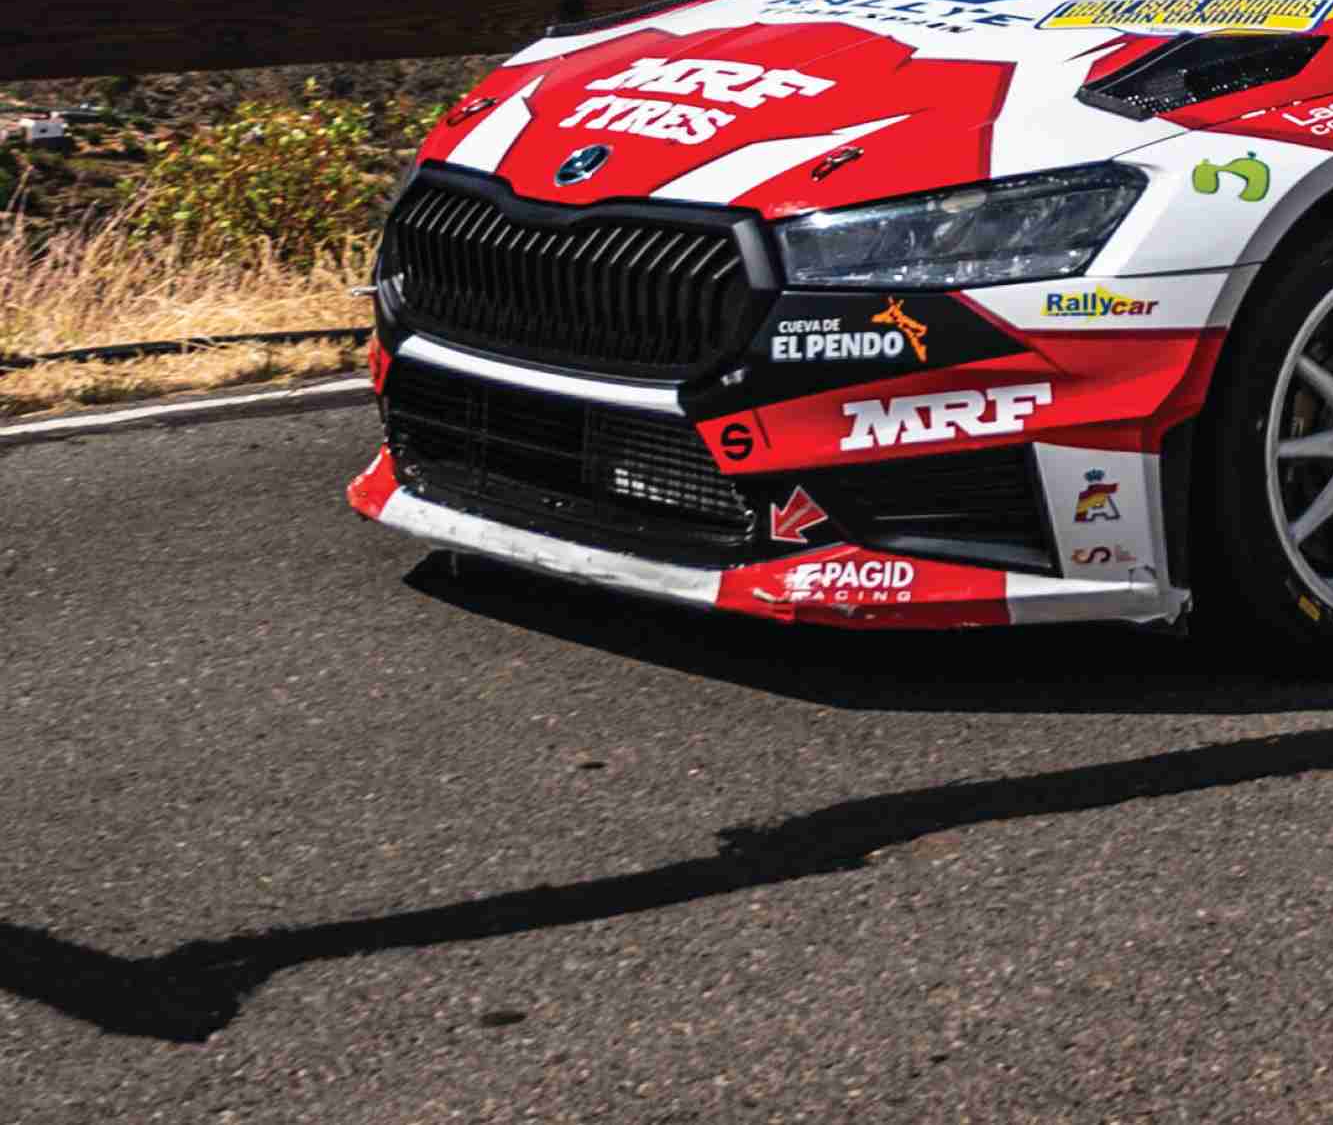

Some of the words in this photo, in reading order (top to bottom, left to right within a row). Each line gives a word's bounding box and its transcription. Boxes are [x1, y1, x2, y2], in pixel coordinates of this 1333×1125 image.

[584, 58, 837, 108] MRF
[559, 95, 737, 145] TYRES
[1046, 291, 1159, 316] Rallycar
[778, 320, 821, 334] CUEVA
[822, 318, 840, 332] DE
[771, 335, 804, 360] EL
[806, 331, 904, 359] PENDO
[840, 382, 1053, 452] MRF
[824, 561, 915, 587] PAGID
